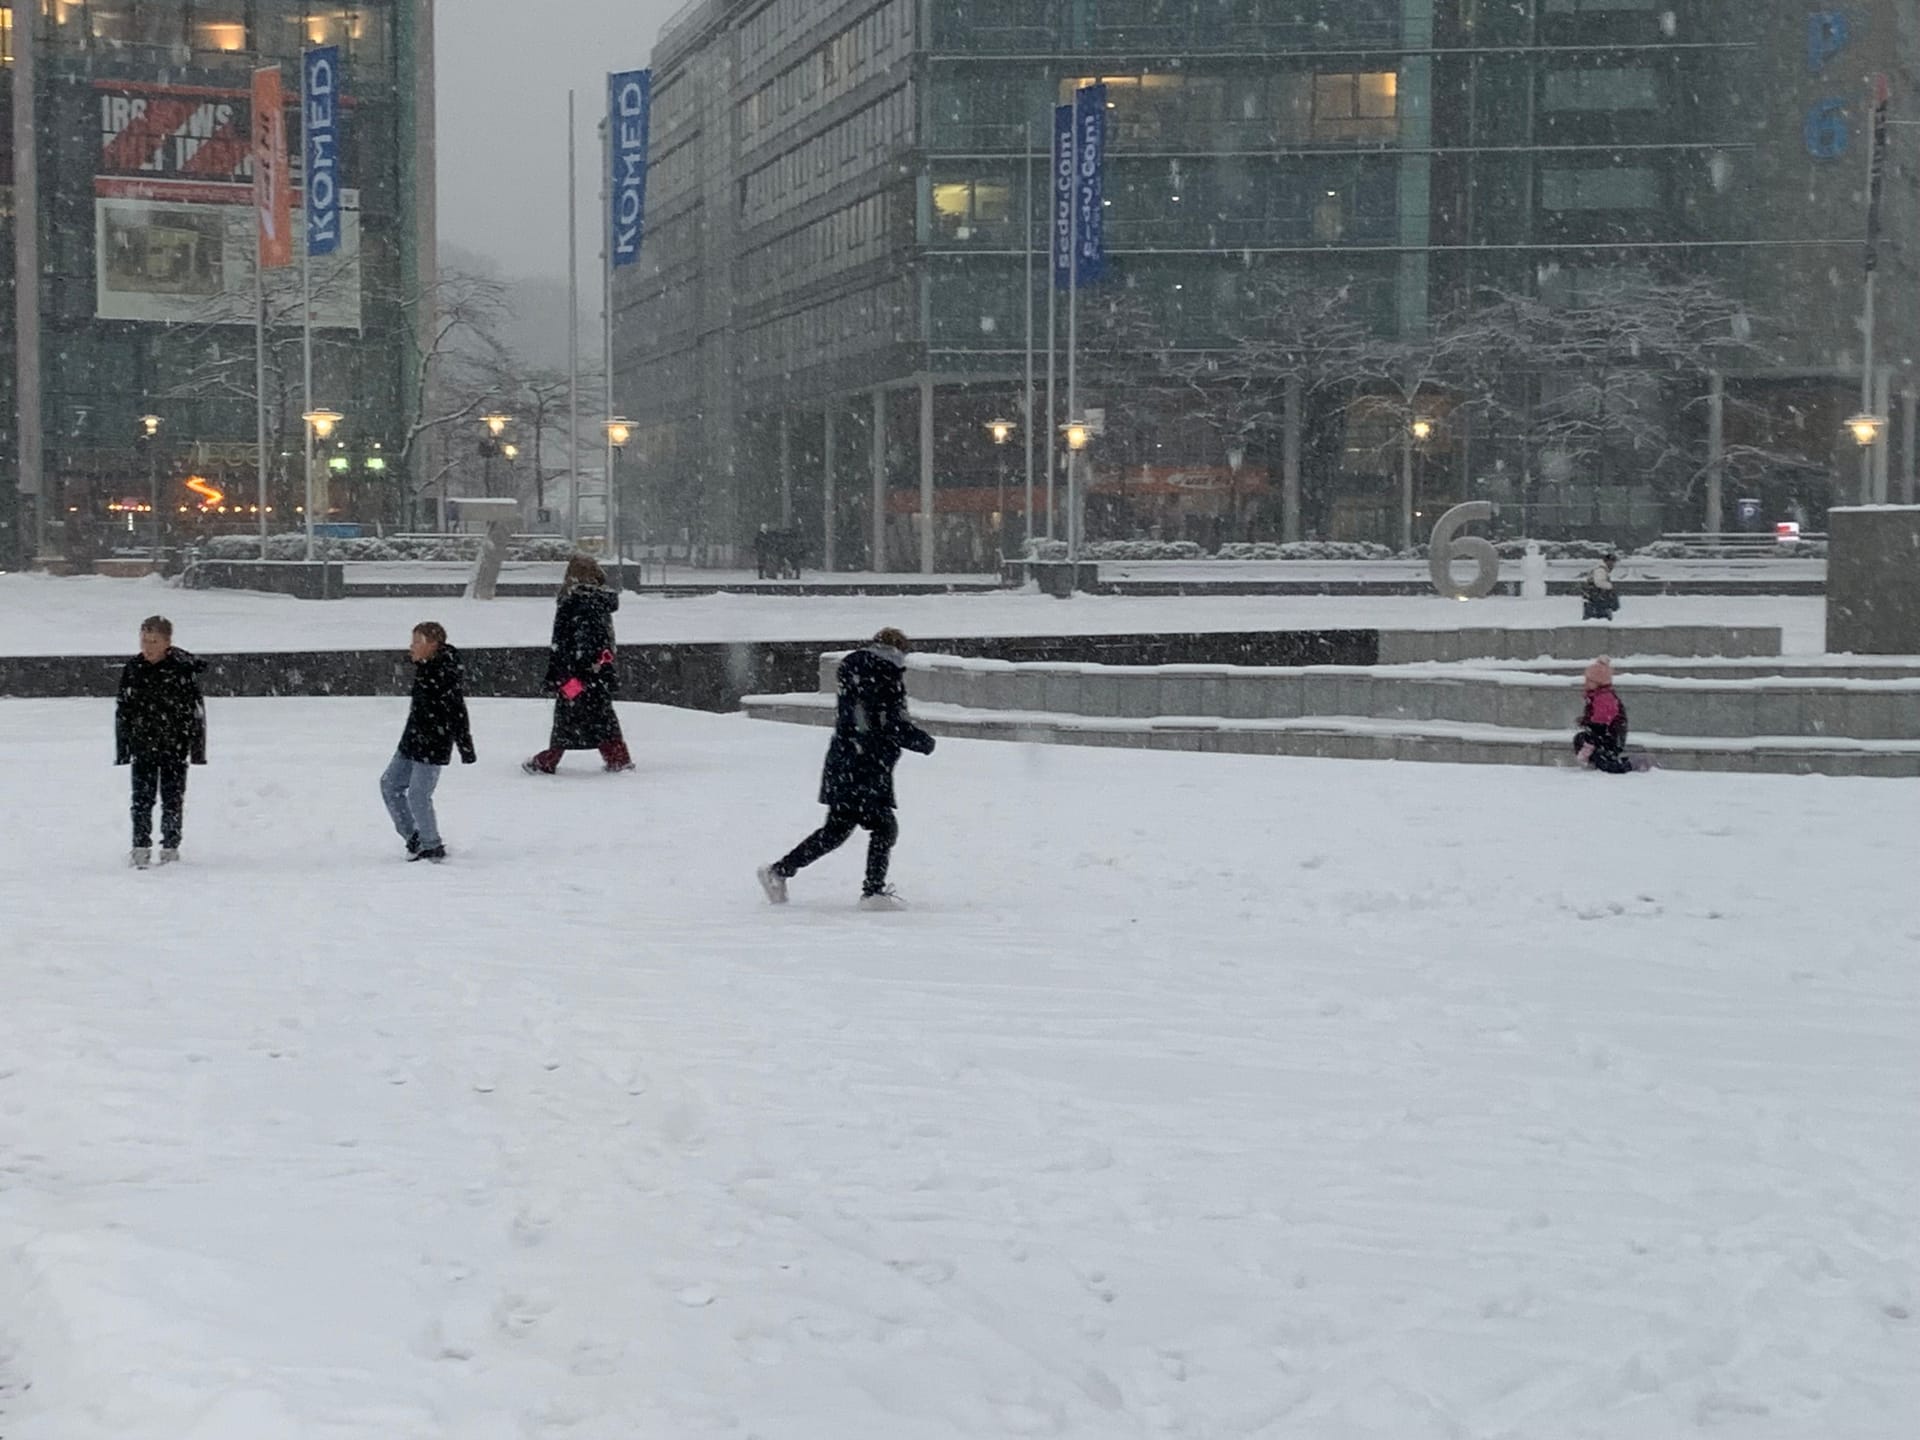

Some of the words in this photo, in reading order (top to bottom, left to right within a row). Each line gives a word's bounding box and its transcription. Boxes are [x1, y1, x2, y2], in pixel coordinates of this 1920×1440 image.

[1807, 11, 1849, 71] P
[311, 58, 335, 241] KOMED
[617, 82, 643, 254] KOMED
[1804, 98, 1850, 159] 6
[1429, 501, 1499, 599] 6
